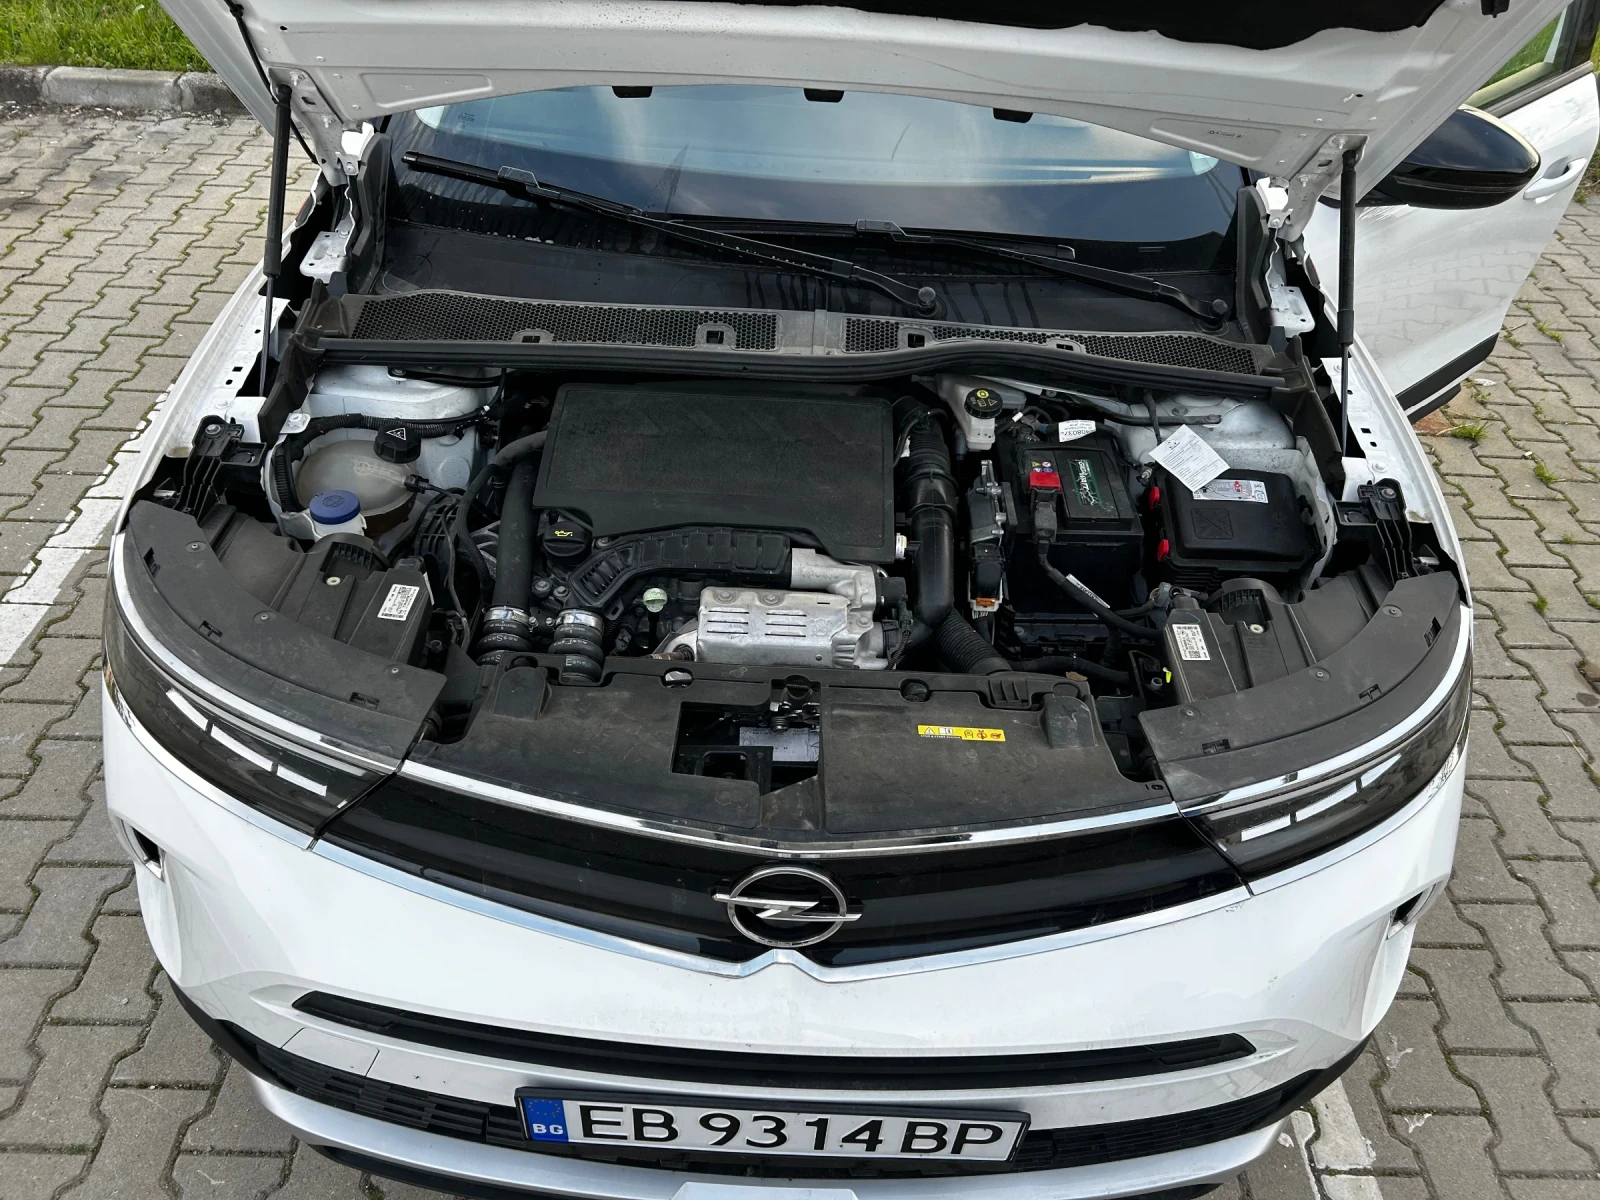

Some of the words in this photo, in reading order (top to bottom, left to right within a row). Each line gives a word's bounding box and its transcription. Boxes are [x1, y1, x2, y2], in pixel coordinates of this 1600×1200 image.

[532, 1123, 563, 1135] BG
[579, 1105, 679, 1143] EB
[699, 1112, 883, 1153] 9314
[900, 1121, 1003, 1155] BP
